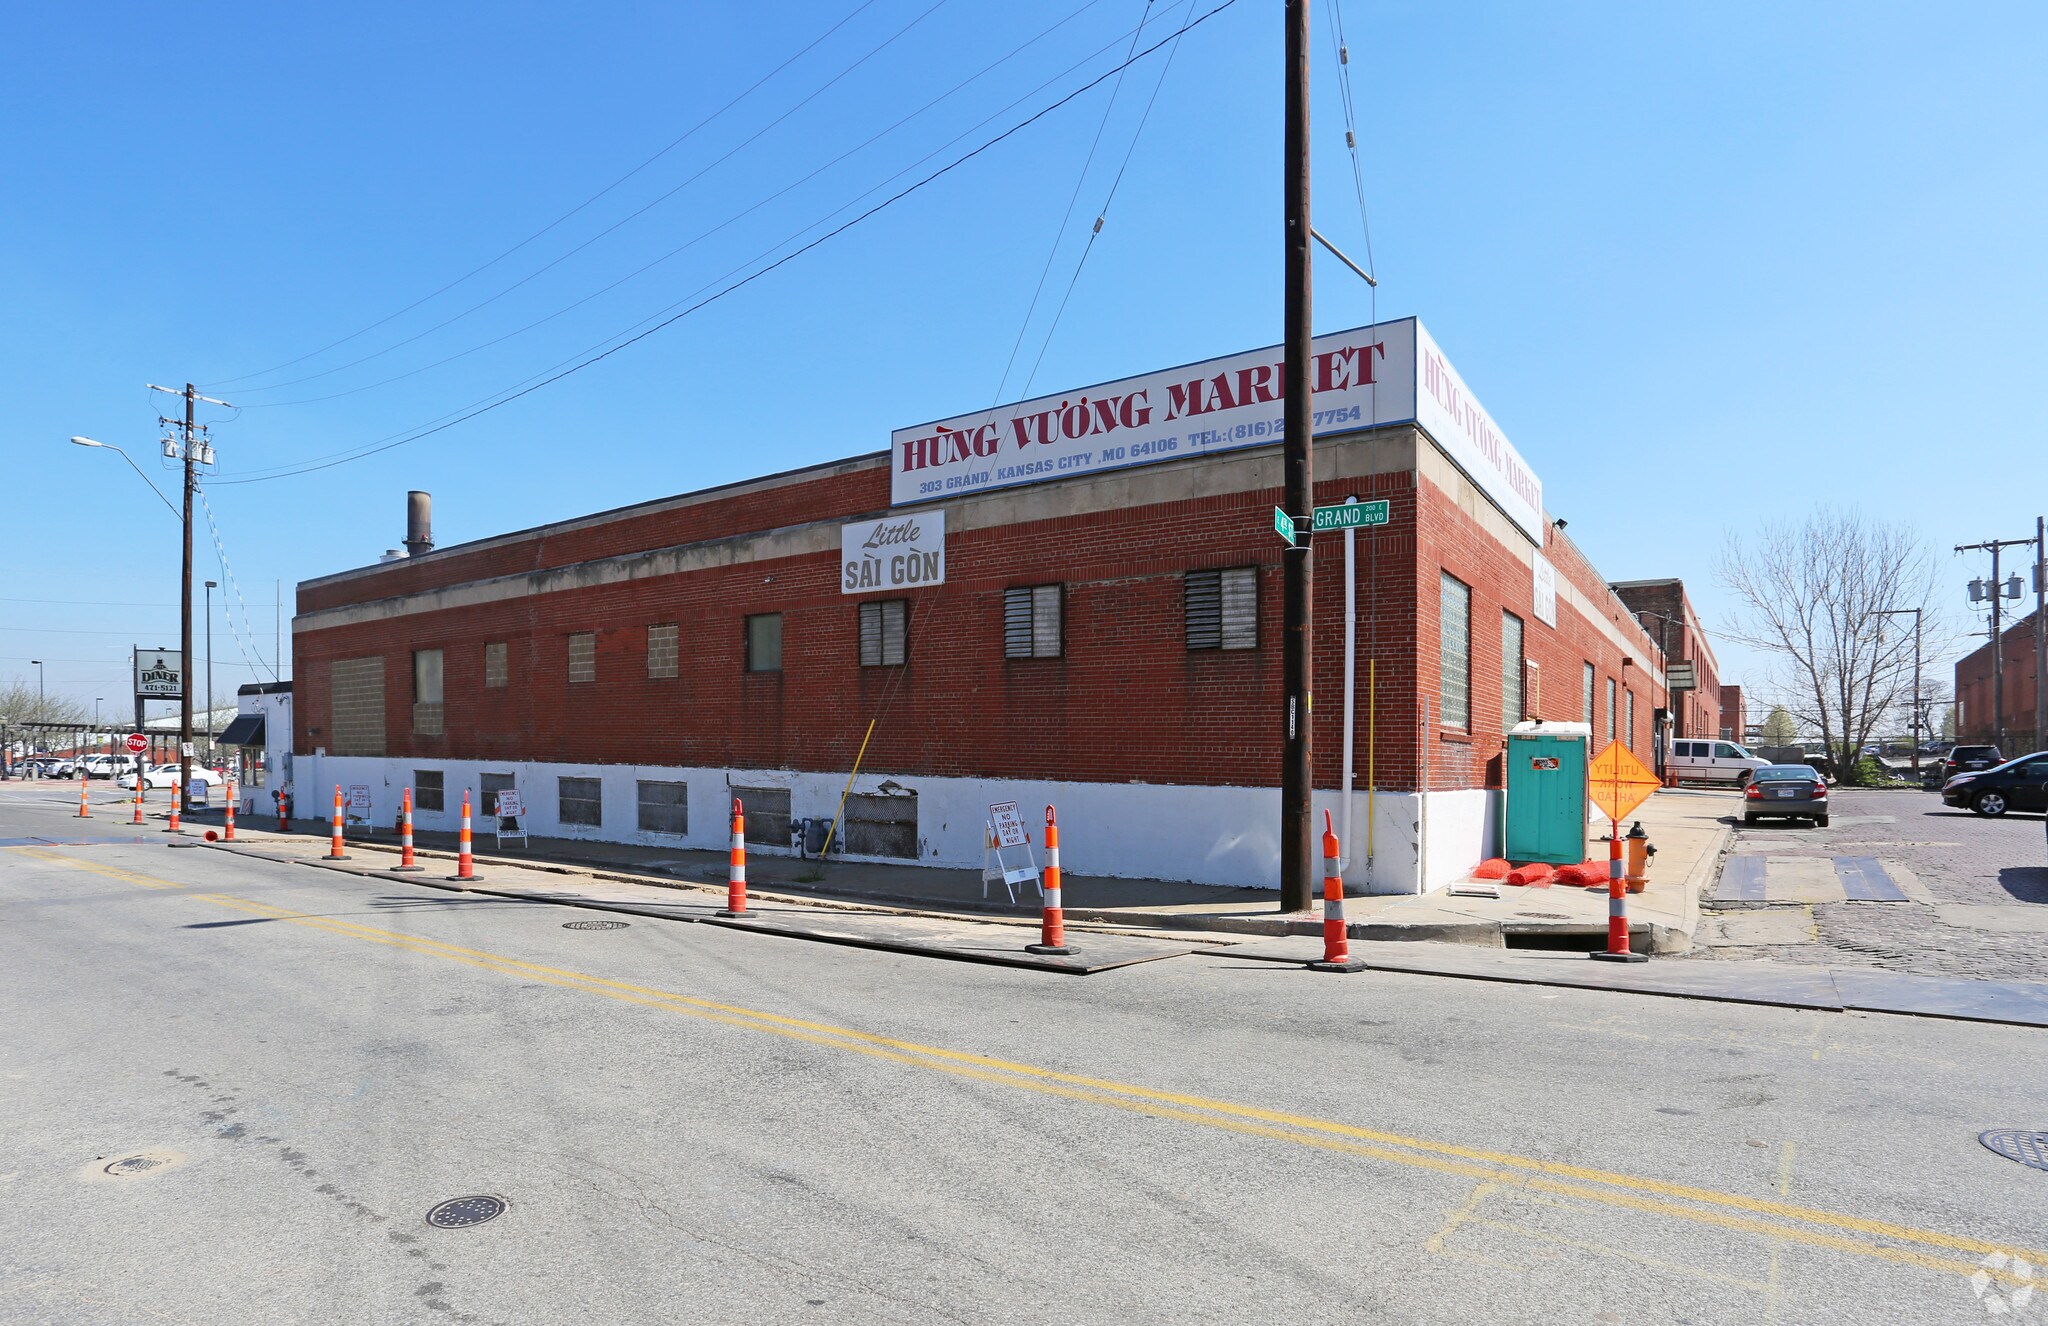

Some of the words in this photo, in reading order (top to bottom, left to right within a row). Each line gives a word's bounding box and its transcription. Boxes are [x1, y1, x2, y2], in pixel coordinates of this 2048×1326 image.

[902, 421, 1000, 472] HÙNG
[919, 477, 943, 494] 303
[997, 459, 1054, 480] KANSAS
[1057, 452, 1093, 470] CITY
[1130, 437, 1178, 458] 64106
[1316, 508, 1361, 527] GRAND
[1365, 512, 1384, 522] BLVD
[862, 519, 921, 549] Little
[845, 553, 881, 590] SÀI
[890, 547, 939, 585] GÒN
[142, 671, 179, 682] DINER
[127, 738, 147, 748] STOP
[992, 804, 1016, 814] EMERGENCY
[999, 820, 1018, 829] PARKING
[1002, 828, 1011, 836] DAY
